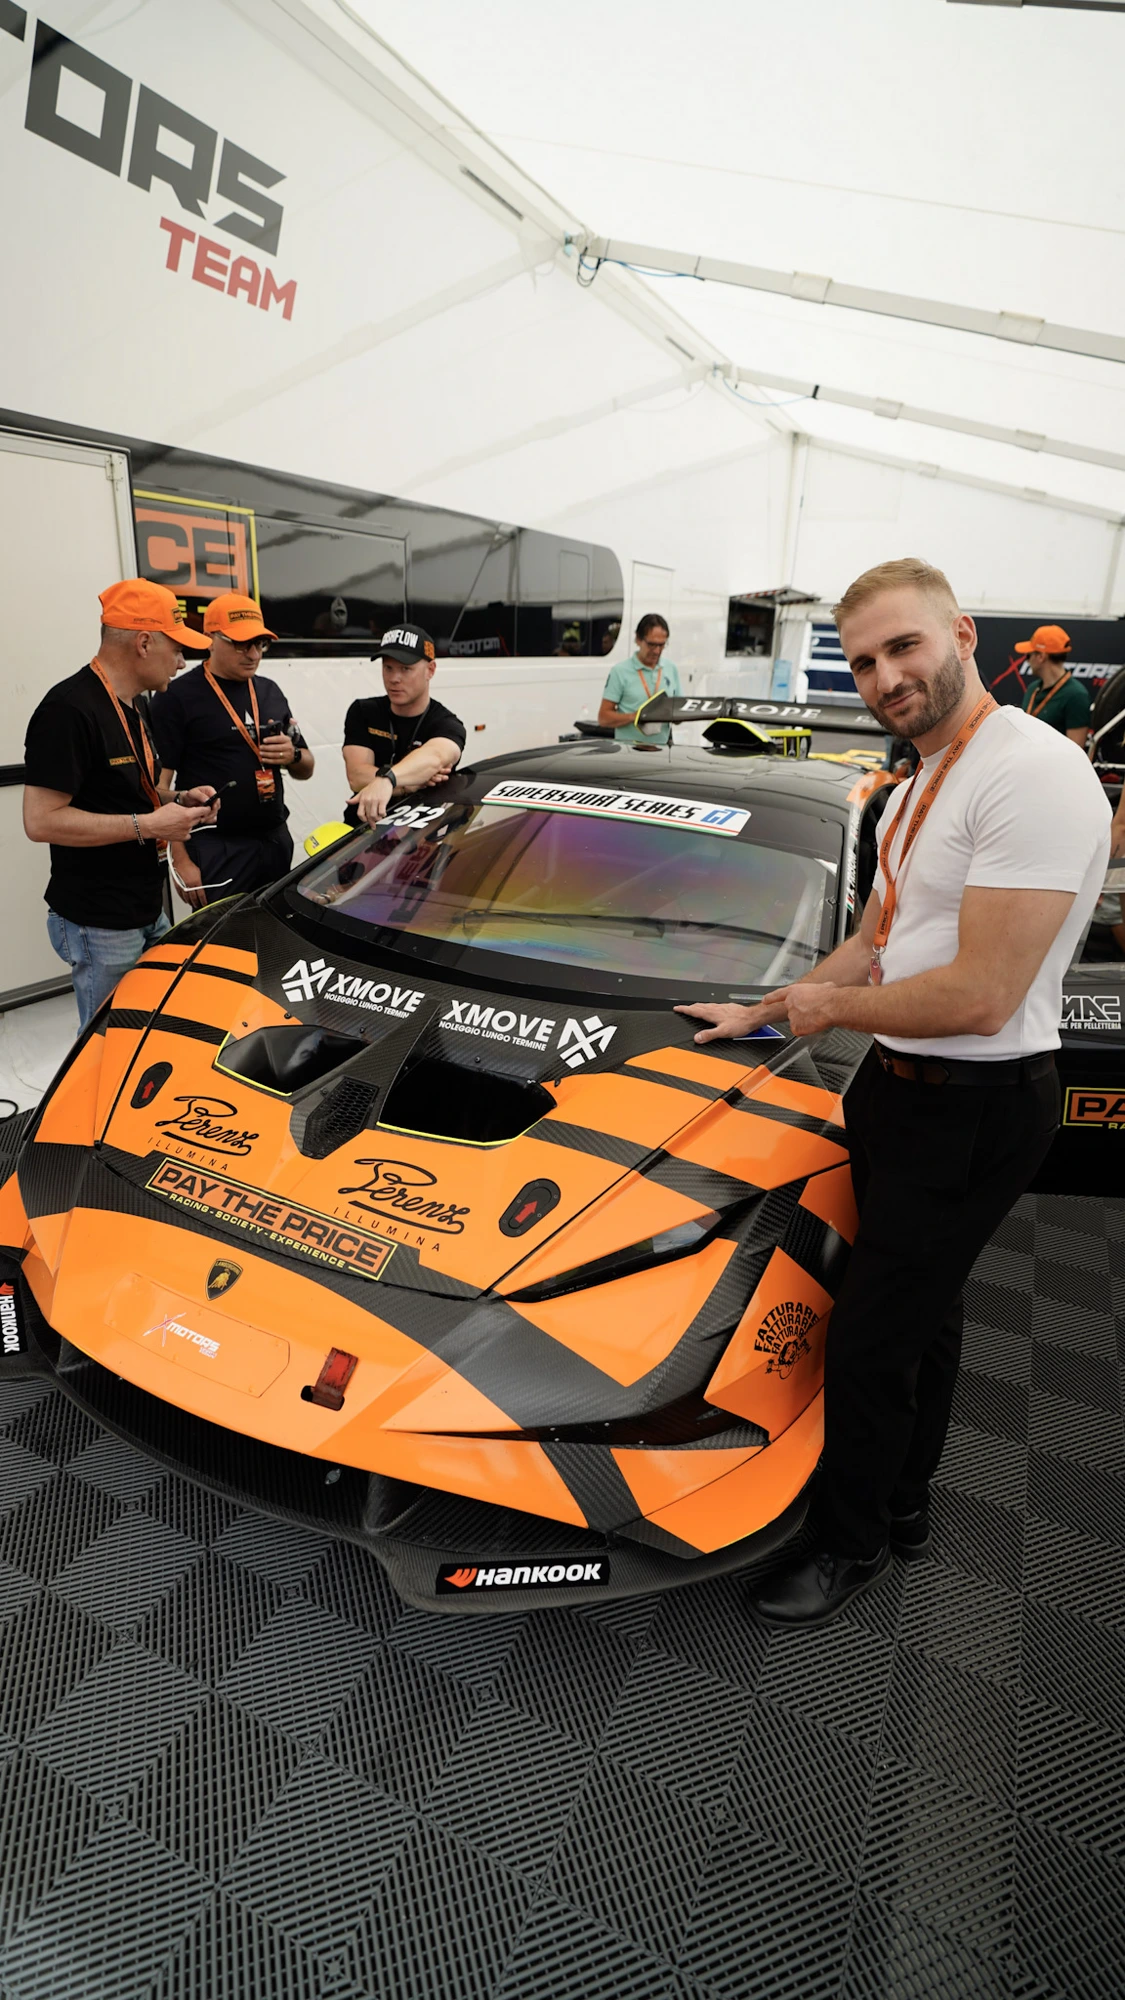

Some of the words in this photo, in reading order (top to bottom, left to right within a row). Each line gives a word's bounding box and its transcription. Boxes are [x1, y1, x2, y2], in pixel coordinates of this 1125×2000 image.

[159, 216, 298, 322] TEAM
[679, 699, 822, 719] EUROPE
[952, 740, 963, 755] PAY
[930, 770, 944, 792] PRICE
[375, 805, 446, 829] 252
[491, 785, 628, 808] SUPERSPORT
[617, 798, 702, 819] SERIES
[700, 808, 750, 826] GT
[917, 804, 927, 818] PAY
[323, 992, 359, 1006] NOLEGGIO
[358, 1001, 383, 1012] LUNGO
[327, 973, 425, 1012] XMOVE
[438, 1020, 481, 1036] NOLEGGIO
[481, 1030, 511, 1043] LUNGO
[512, 1036, 548, 1051] TERMINE
[441, 999, 557, 1043] XMOVE
[1070, 1022, 1082, 1030] PER
[1084, 1022, 1122, 1030] PELLETTERIA
[147, 1136, 229, 1171] ILLUMINA
[157, 1166, 220, 1199] PAY
[221, 1187, 283, 1227] THE
[280, 1212, 384, 1268] PRICE
[169, 1193, 210, 1213] RACING
[214, 1210, 264, 1234] SOCIETY
[269, 1232, 346, 1269] EXPERIENCE
[333, 1206, 441, 1252] ILLUMINA
